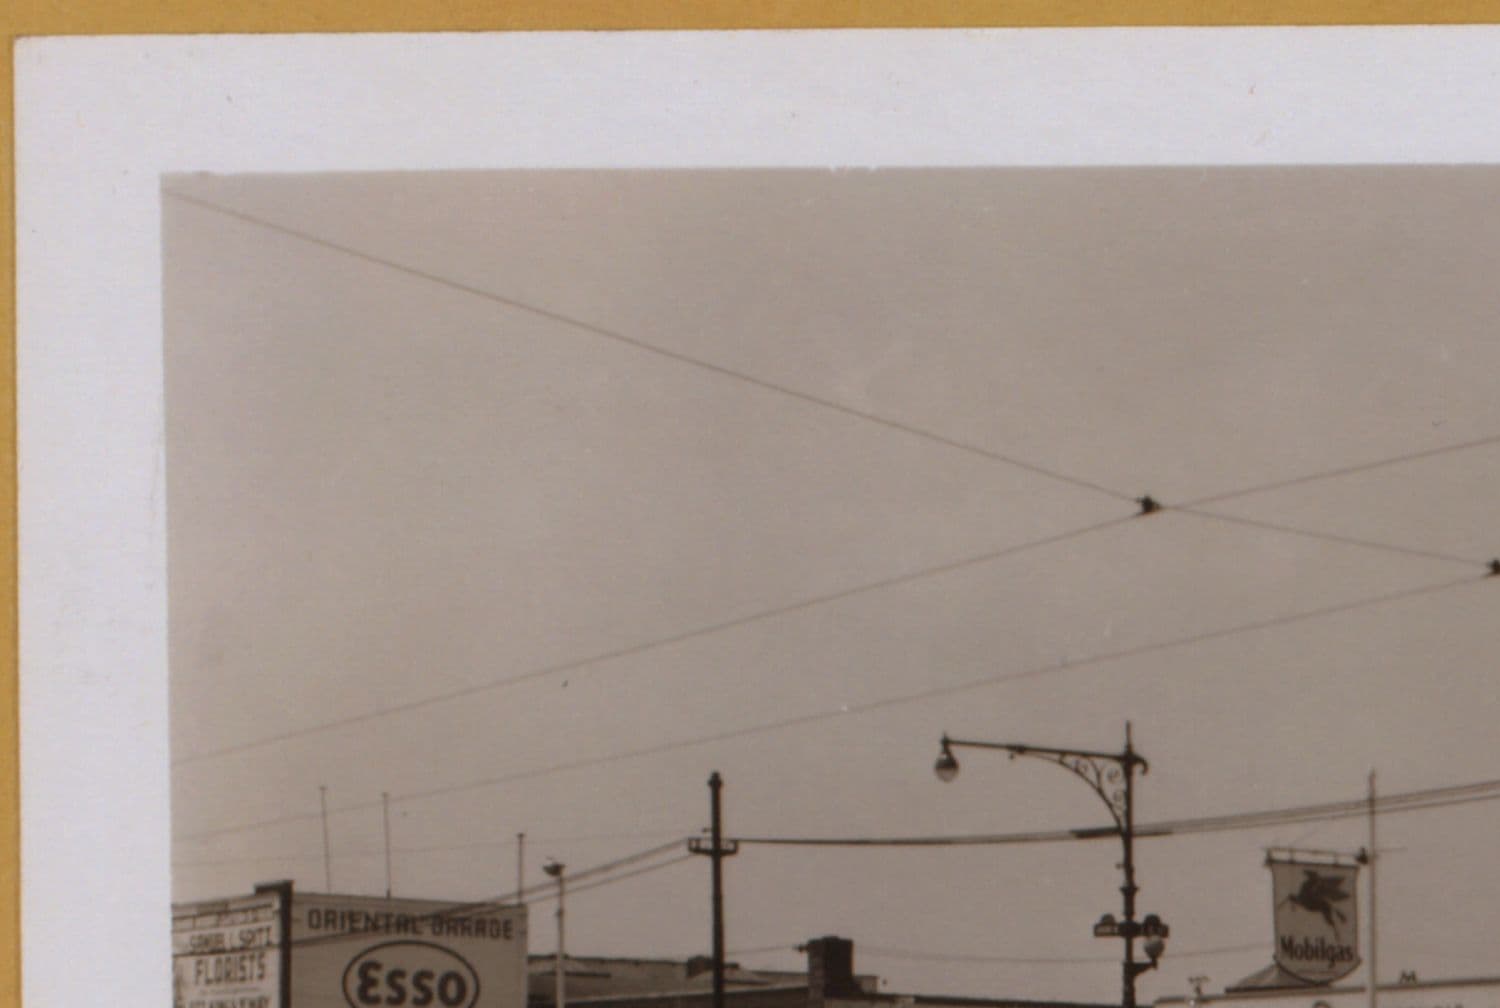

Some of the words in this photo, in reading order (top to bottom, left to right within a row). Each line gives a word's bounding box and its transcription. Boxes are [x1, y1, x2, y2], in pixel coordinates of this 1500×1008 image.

[308, 908, 424, 936] ORIENTAL
[431, 915, 514, 941] GARAGE
[195, 952, 267, 984] FLORISTS
[1280, 936, 1353, 969] Mobilgas
